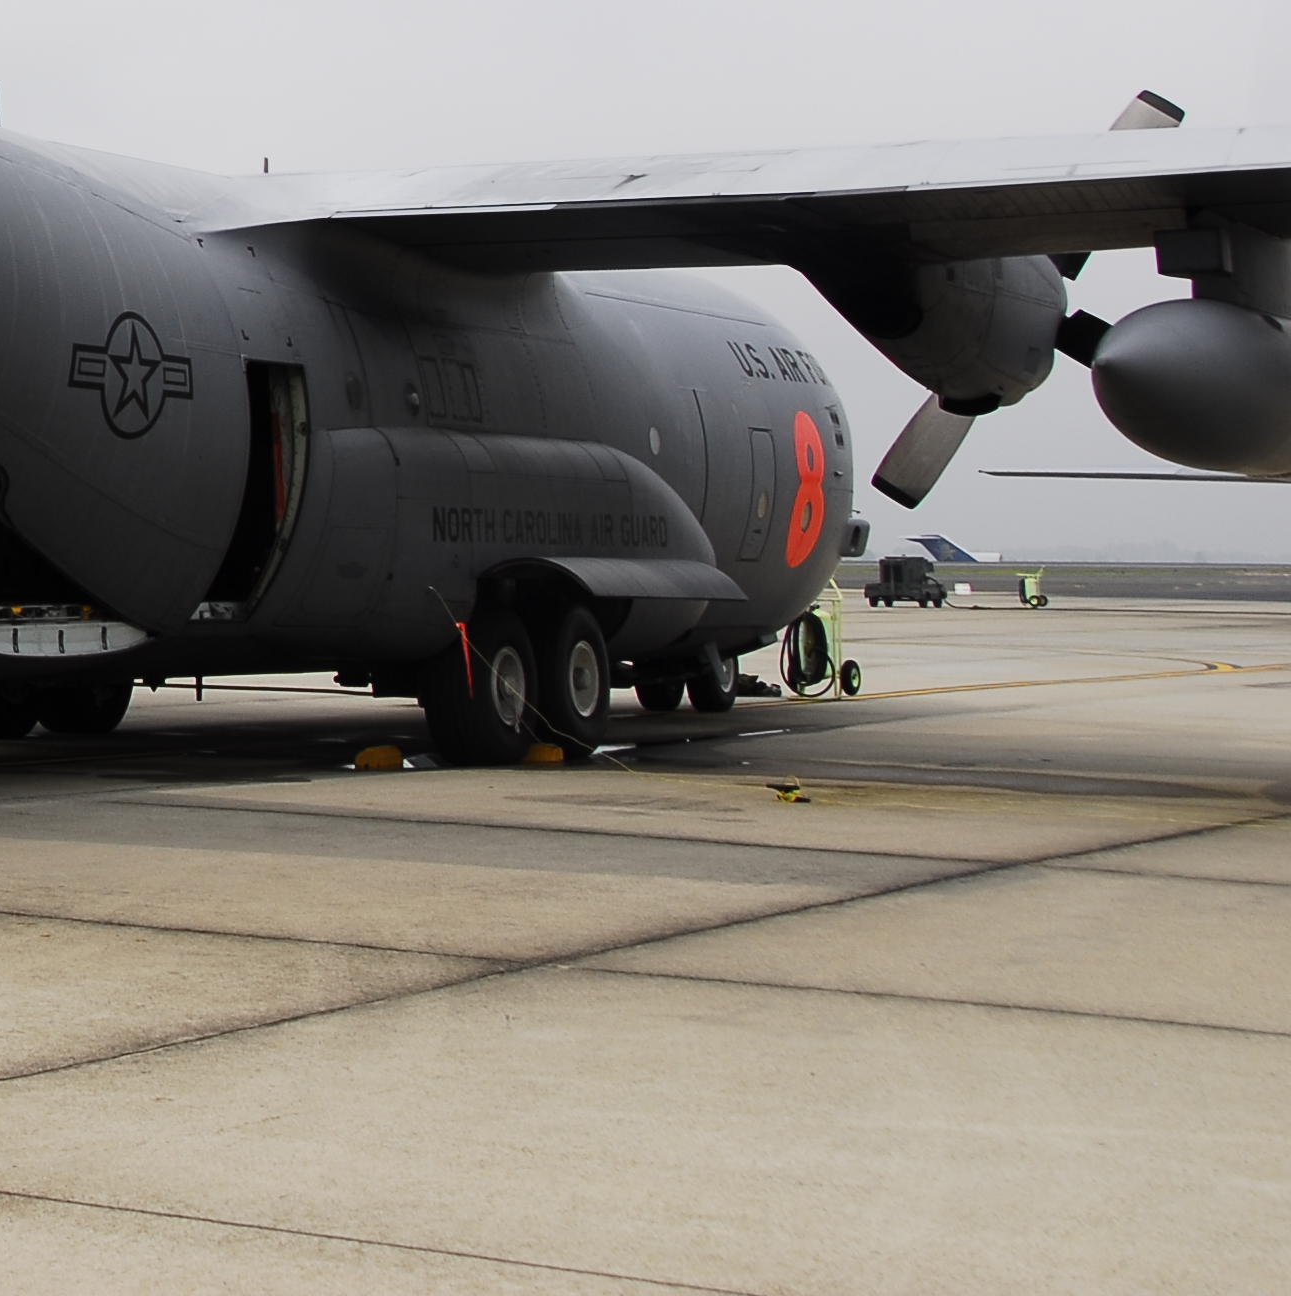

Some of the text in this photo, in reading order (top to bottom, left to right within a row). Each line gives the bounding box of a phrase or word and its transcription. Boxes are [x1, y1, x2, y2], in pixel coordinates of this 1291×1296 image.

[726, 340, 776, 380] U.S.
[768, 345, 809, 383] AIR
[785, 409, 826, 569] 8
[431, 505, 668, 548] NORTH CAROLINA AIR GUARD
